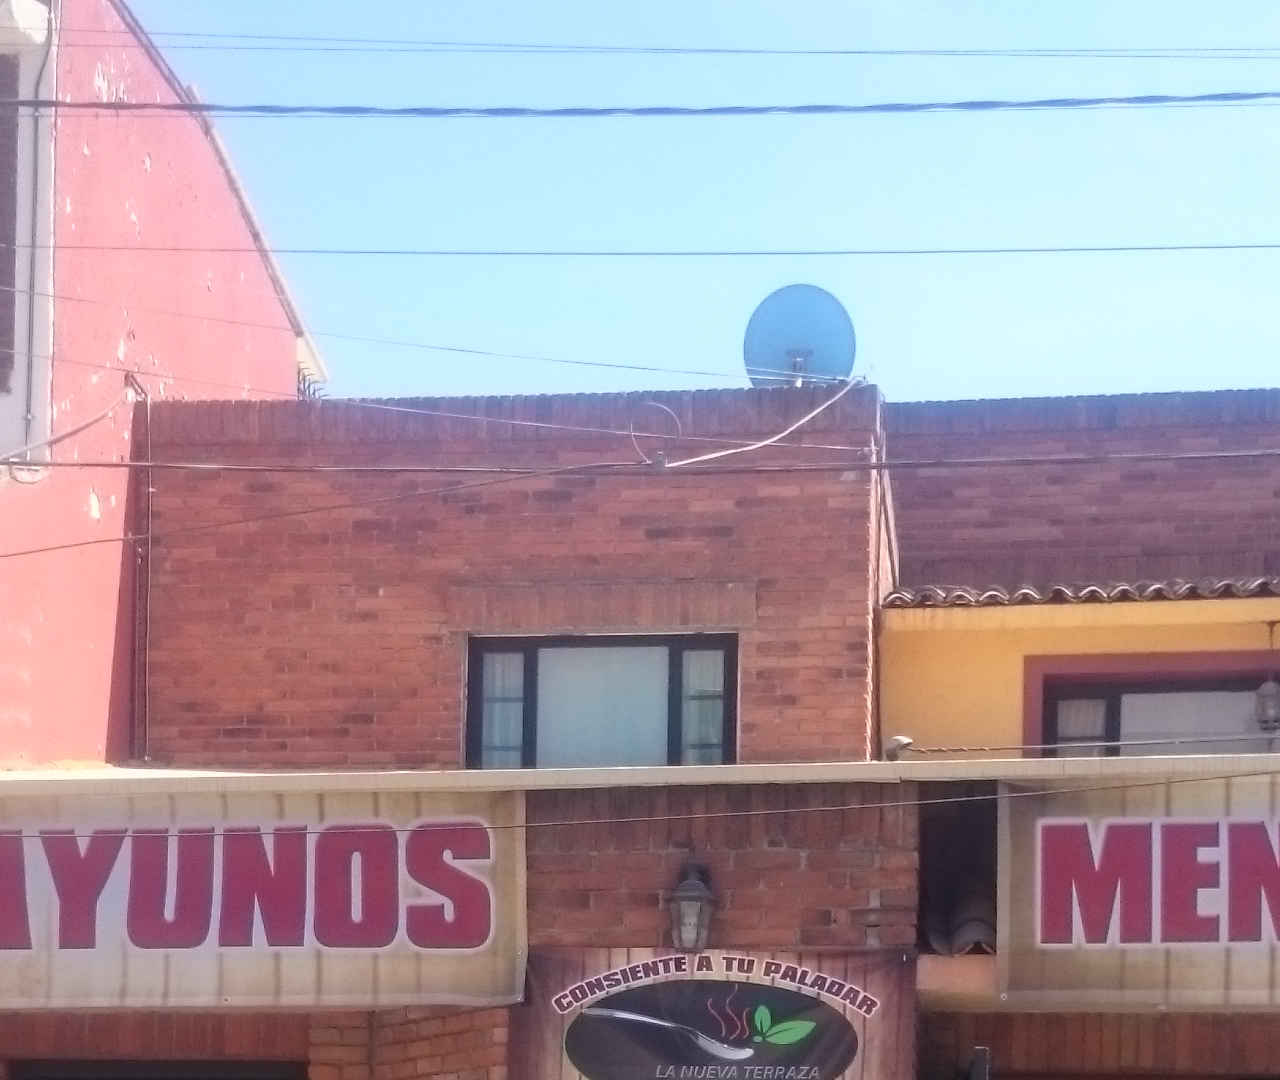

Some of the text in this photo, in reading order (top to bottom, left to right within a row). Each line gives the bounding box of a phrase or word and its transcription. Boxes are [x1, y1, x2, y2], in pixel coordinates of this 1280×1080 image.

[553, 954, 880, 1016] CONSIENTE A TU PALADAR
[655, 1065, 820, 1079] LA NUEVA TERRAZA
